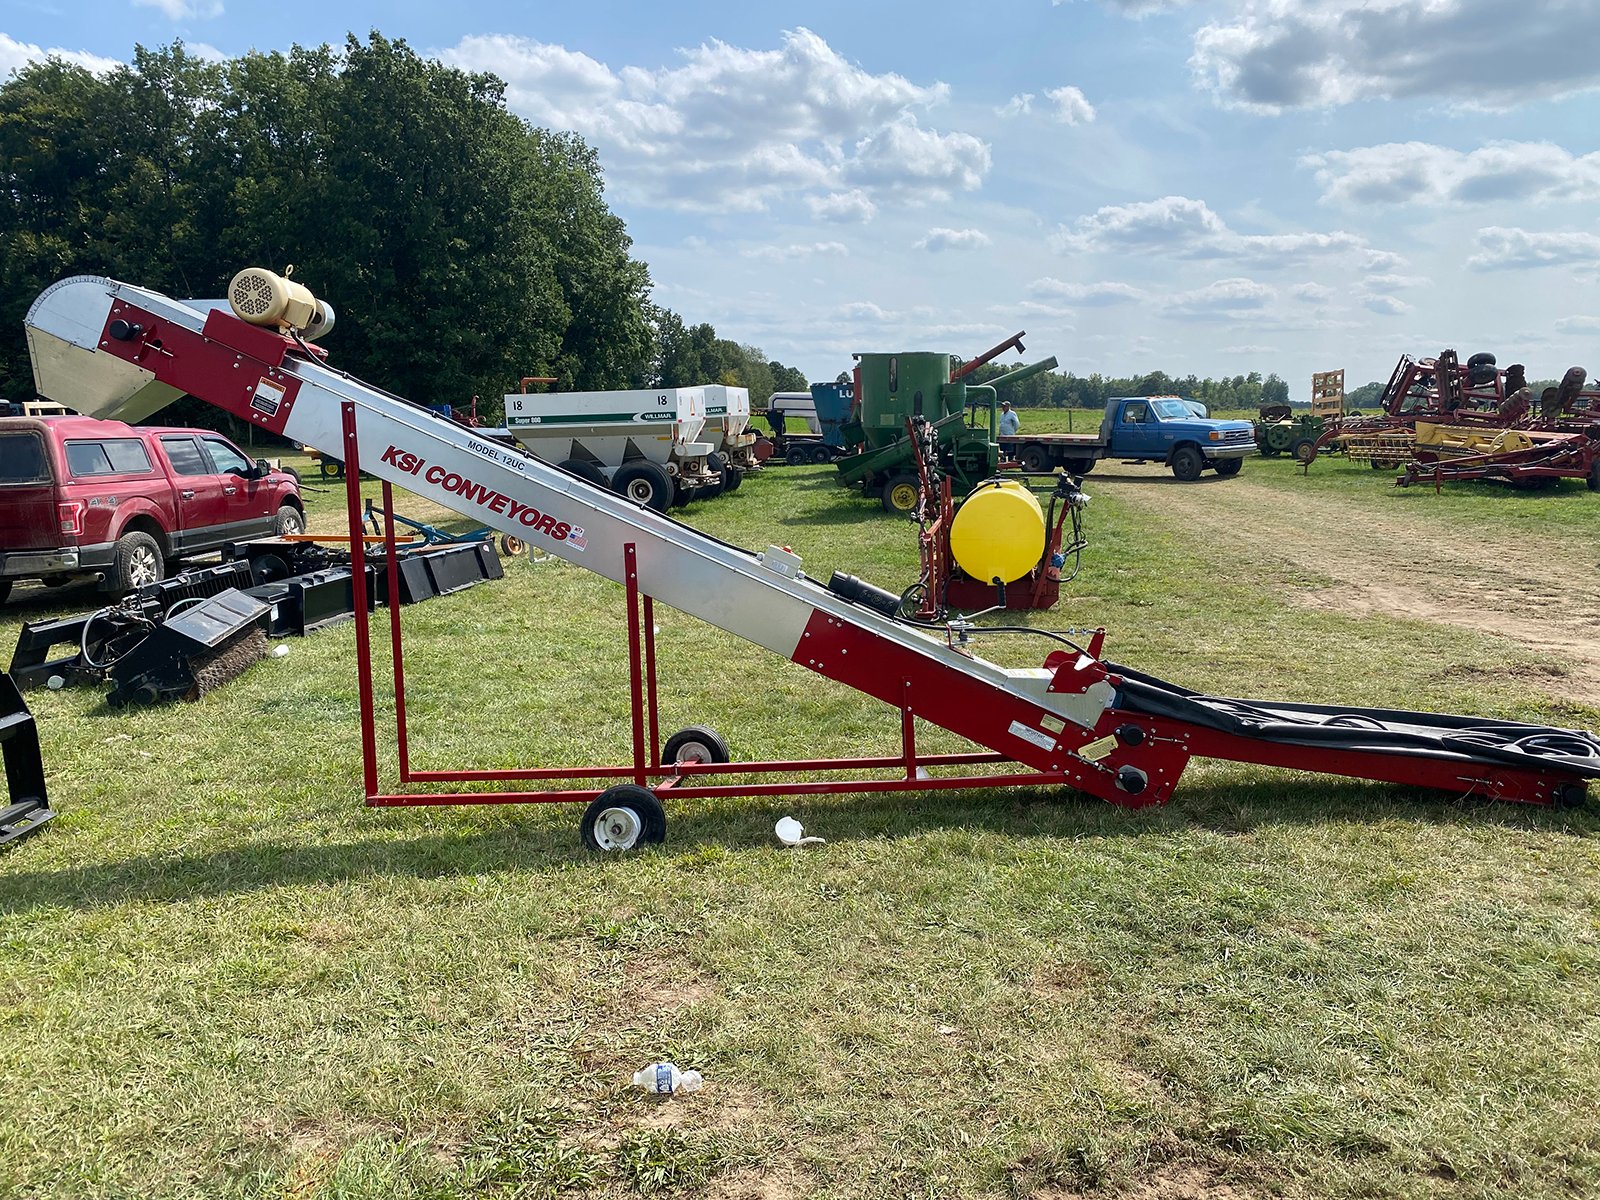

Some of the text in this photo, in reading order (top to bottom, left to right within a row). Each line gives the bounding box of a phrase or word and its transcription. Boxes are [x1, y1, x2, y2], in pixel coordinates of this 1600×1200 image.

[839, 389, 854, 399] LU
[512, 400, 523, 411] 18
[657, 395, 668, 406] 18
[514, 417, 530, 425] Super
[467, 440, 526, 471] MODEL 12UC
[380, 445, 572, 541] KSI CONVEYORS
